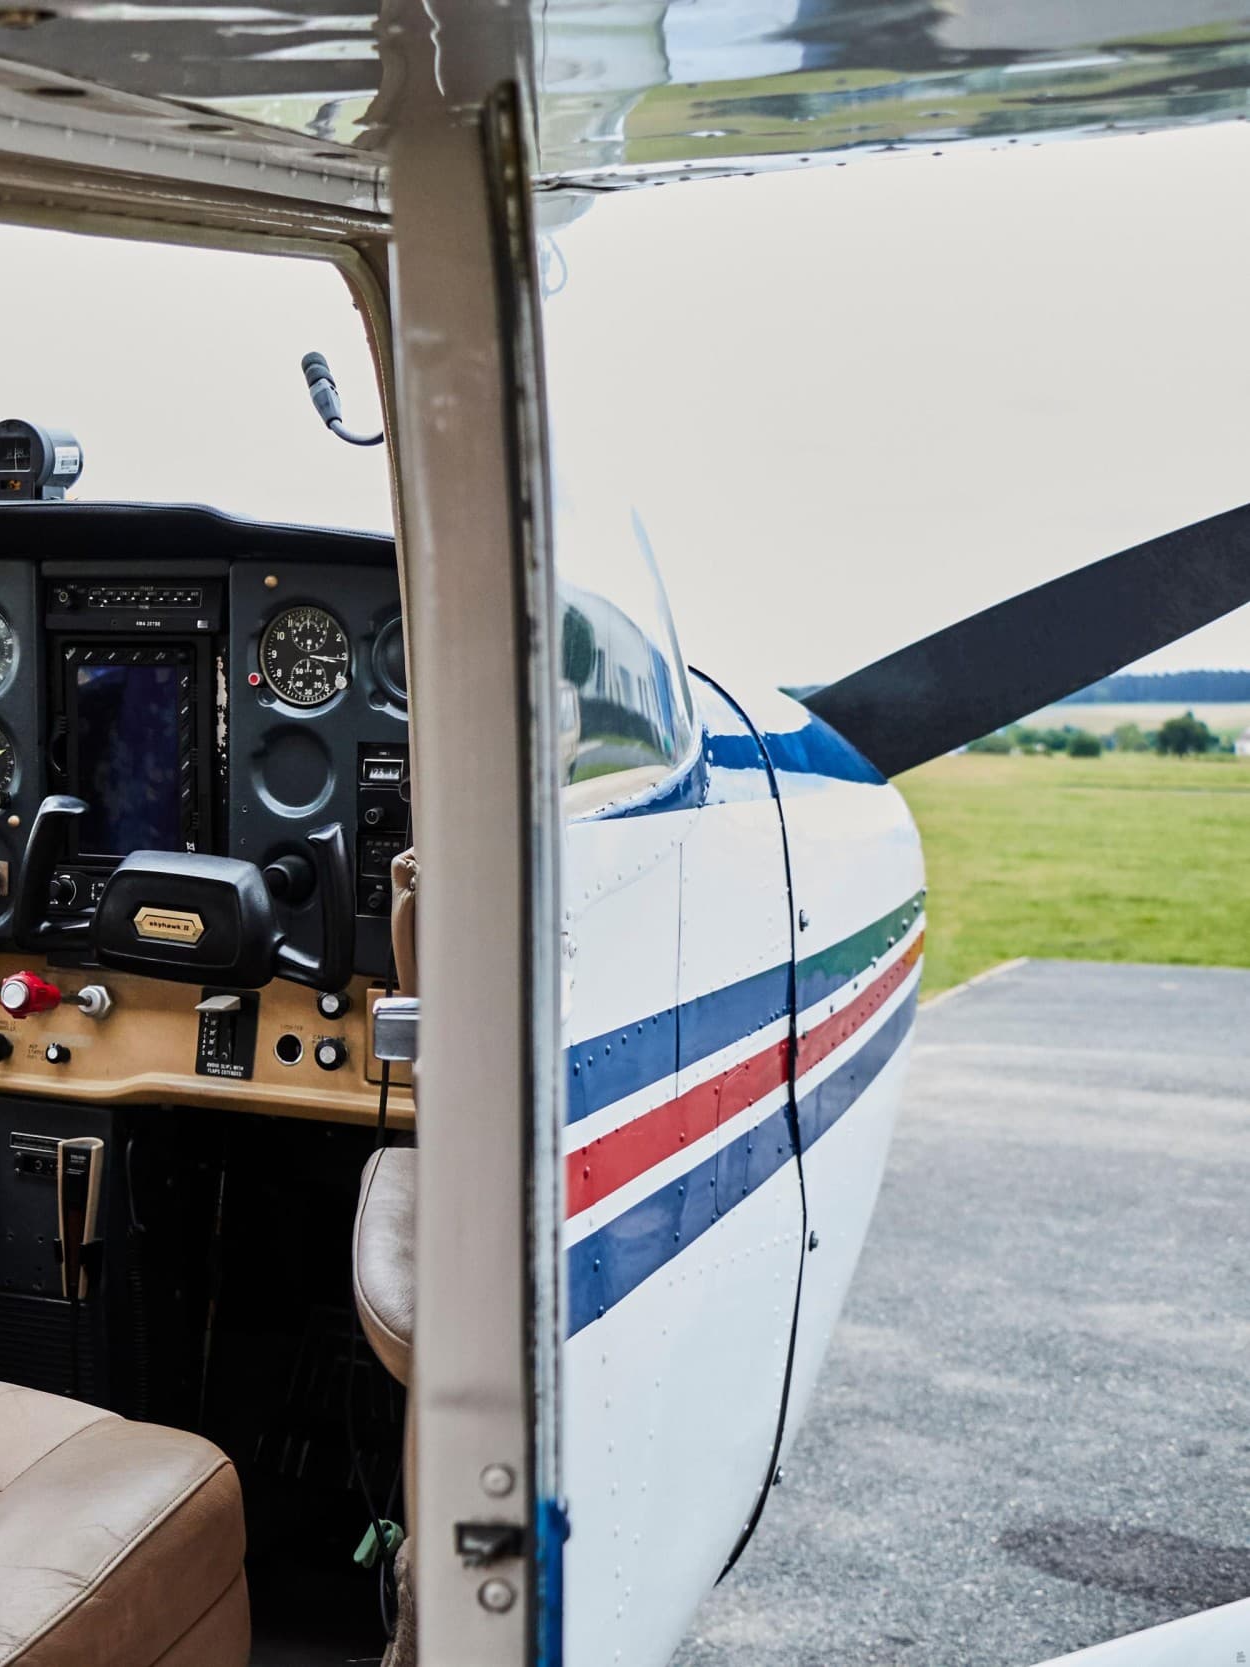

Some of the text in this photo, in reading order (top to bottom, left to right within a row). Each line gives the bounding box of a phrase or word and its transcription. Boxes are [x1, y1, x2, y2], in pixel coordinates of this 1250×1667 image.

[277, 632, 285, 640] 10
[336, 633, 342, 642] 2
[271, 650, 277, 658] 9
[150, 921, 181, 930] skyhawk
